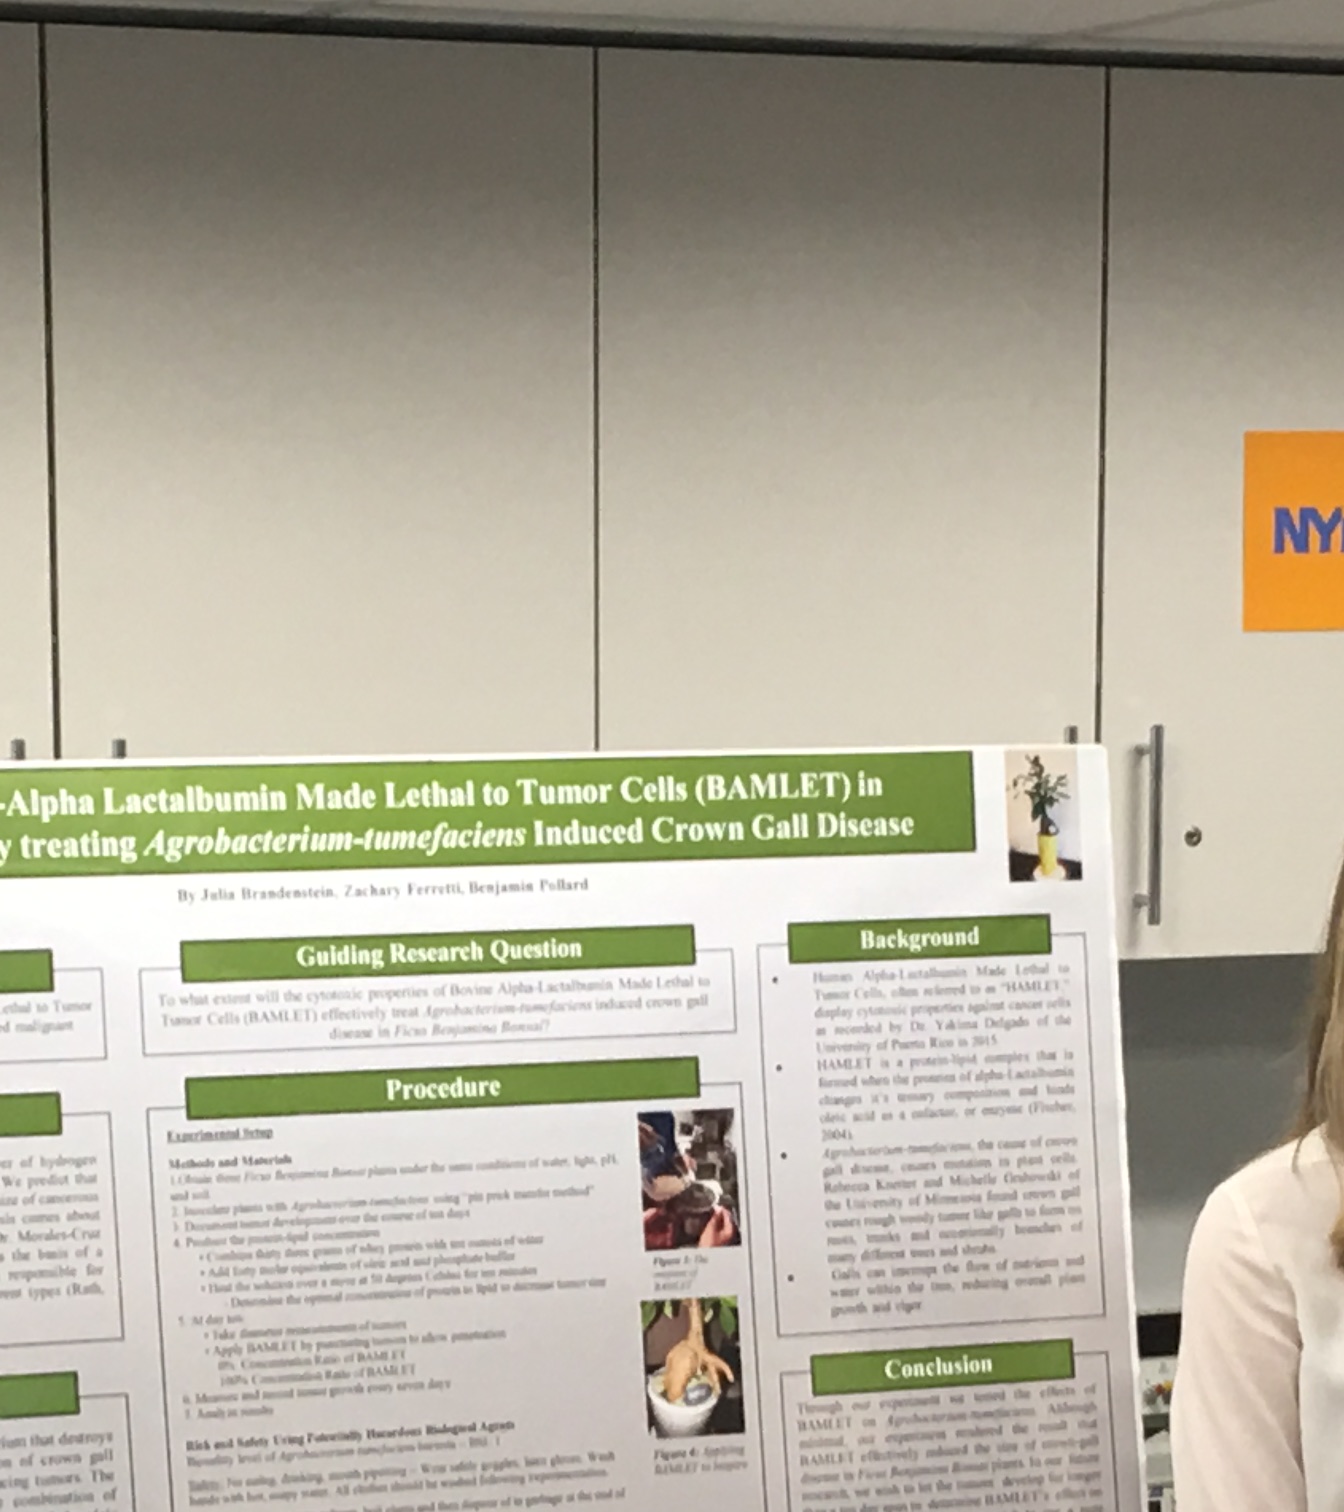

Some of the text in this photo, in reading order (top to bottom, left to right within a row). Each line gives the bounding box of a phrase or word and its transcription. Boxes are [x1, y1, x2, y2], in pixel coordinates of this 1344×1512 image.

[103, 784, 287, 814] Lactalbumin
[296, 782, 376, 810] Made
[384, 780, 475, 808] Lethal
[482, 783, 509, 805] to
[515, 778, 612, 805] Tumor
[620, 775, 687, 802] Cells
[695, 771, 851, 805] (BAMLET)
[858, 770, 882, 796] in
[20, 831, 138, 863] treating
[142, 821, 527, 862] Agrobacterium-tumefaciens
[534, 817, 643, 846] Induced
[651, 816, 744, 843] Crown
[751, 812, 809, 840] Gall
[817, 812, 914, 837] Disease
[296, 937, 582, 969] Guiding Research Question
[860, 926, 979, 952] Background
[386, 1076, 501, 1100] Procedure
[884, 1354, 992, 1379] Conclusion
